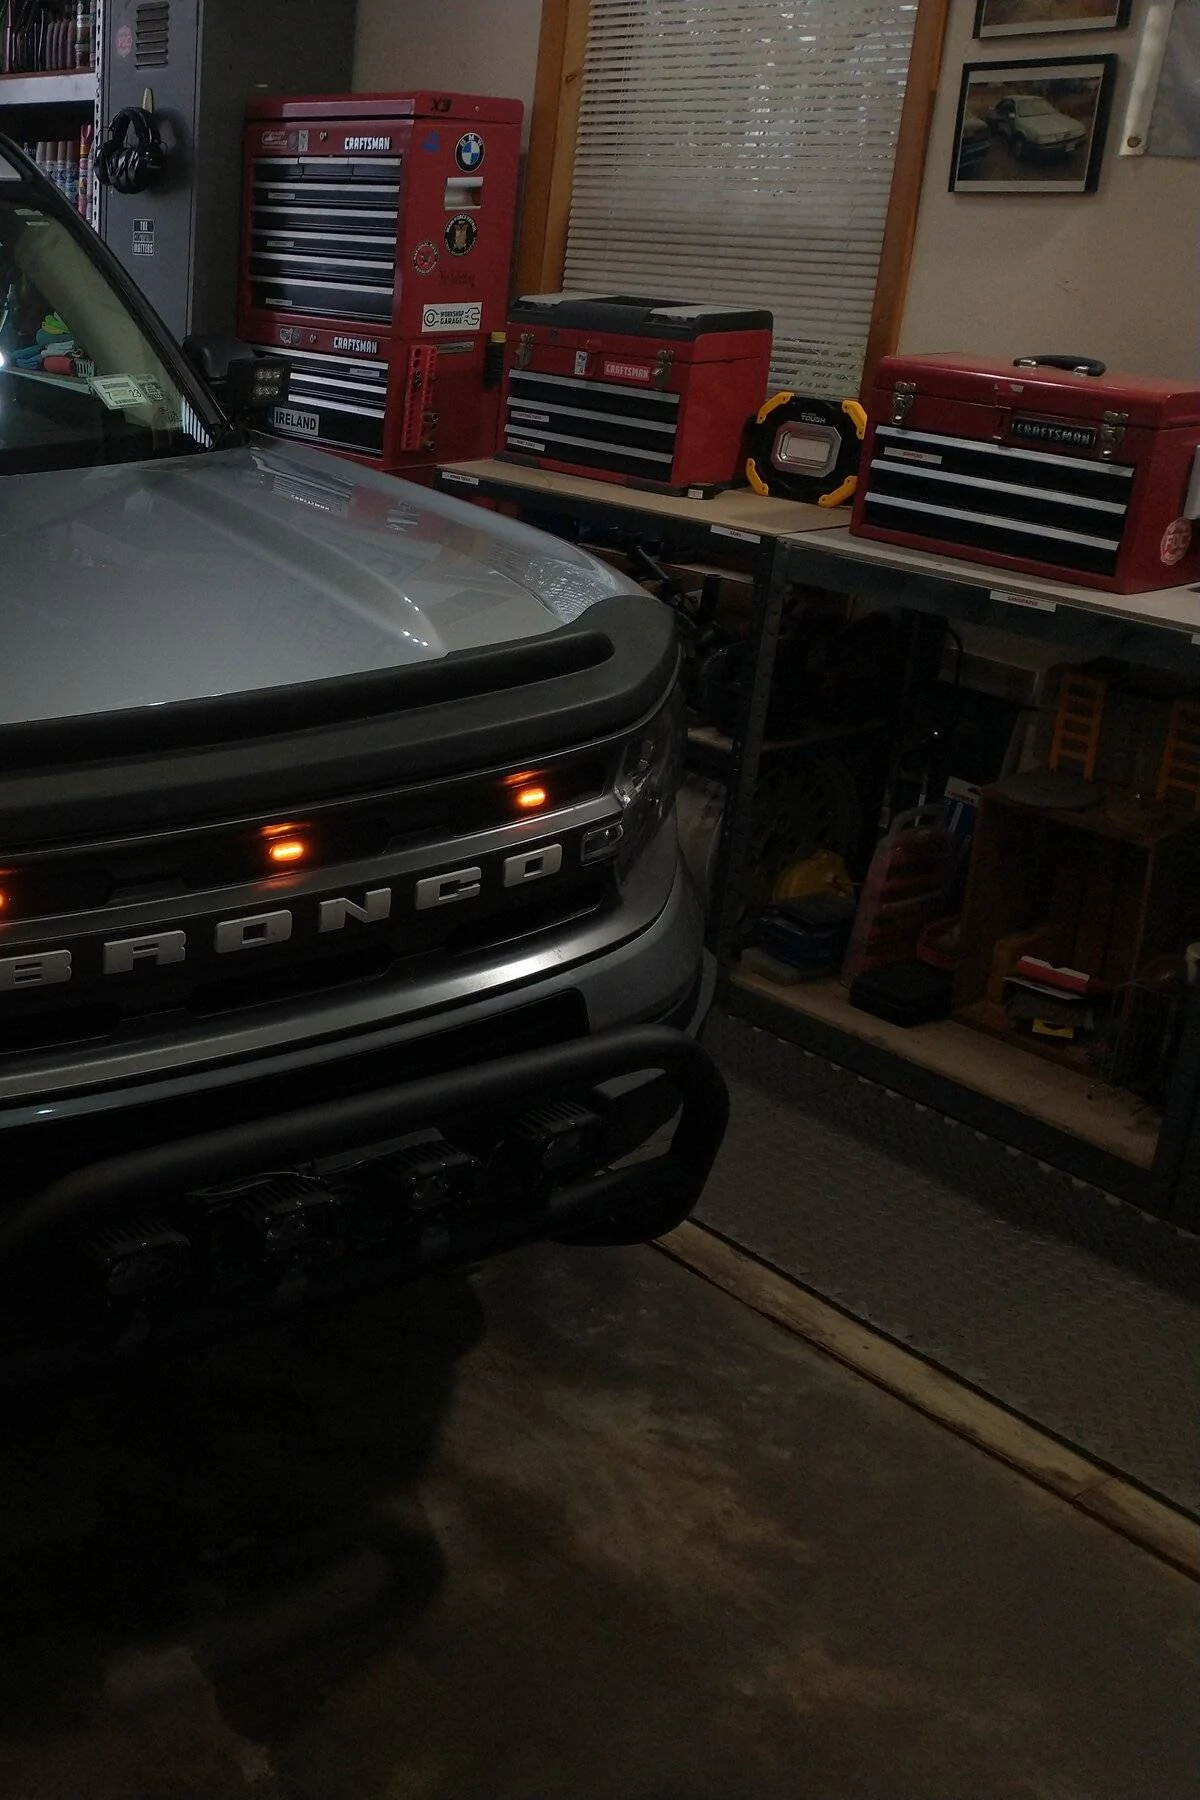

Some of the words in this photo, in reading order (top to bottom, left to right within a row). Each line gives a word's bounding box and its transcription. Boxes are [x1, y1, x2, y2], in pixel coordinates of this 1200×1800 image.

[344, 136, 391, 150] CRAFTSMAN
[440, 317, 463, 325] GARAGE
[333, 336, 378, 354] CRAFTSMAN
[605, 363, 650, 379] CRAFTSMAN
[275, 410, 316, 430] IRELAND
[1016, 422, 1091, 445] CRAFTSMAN
